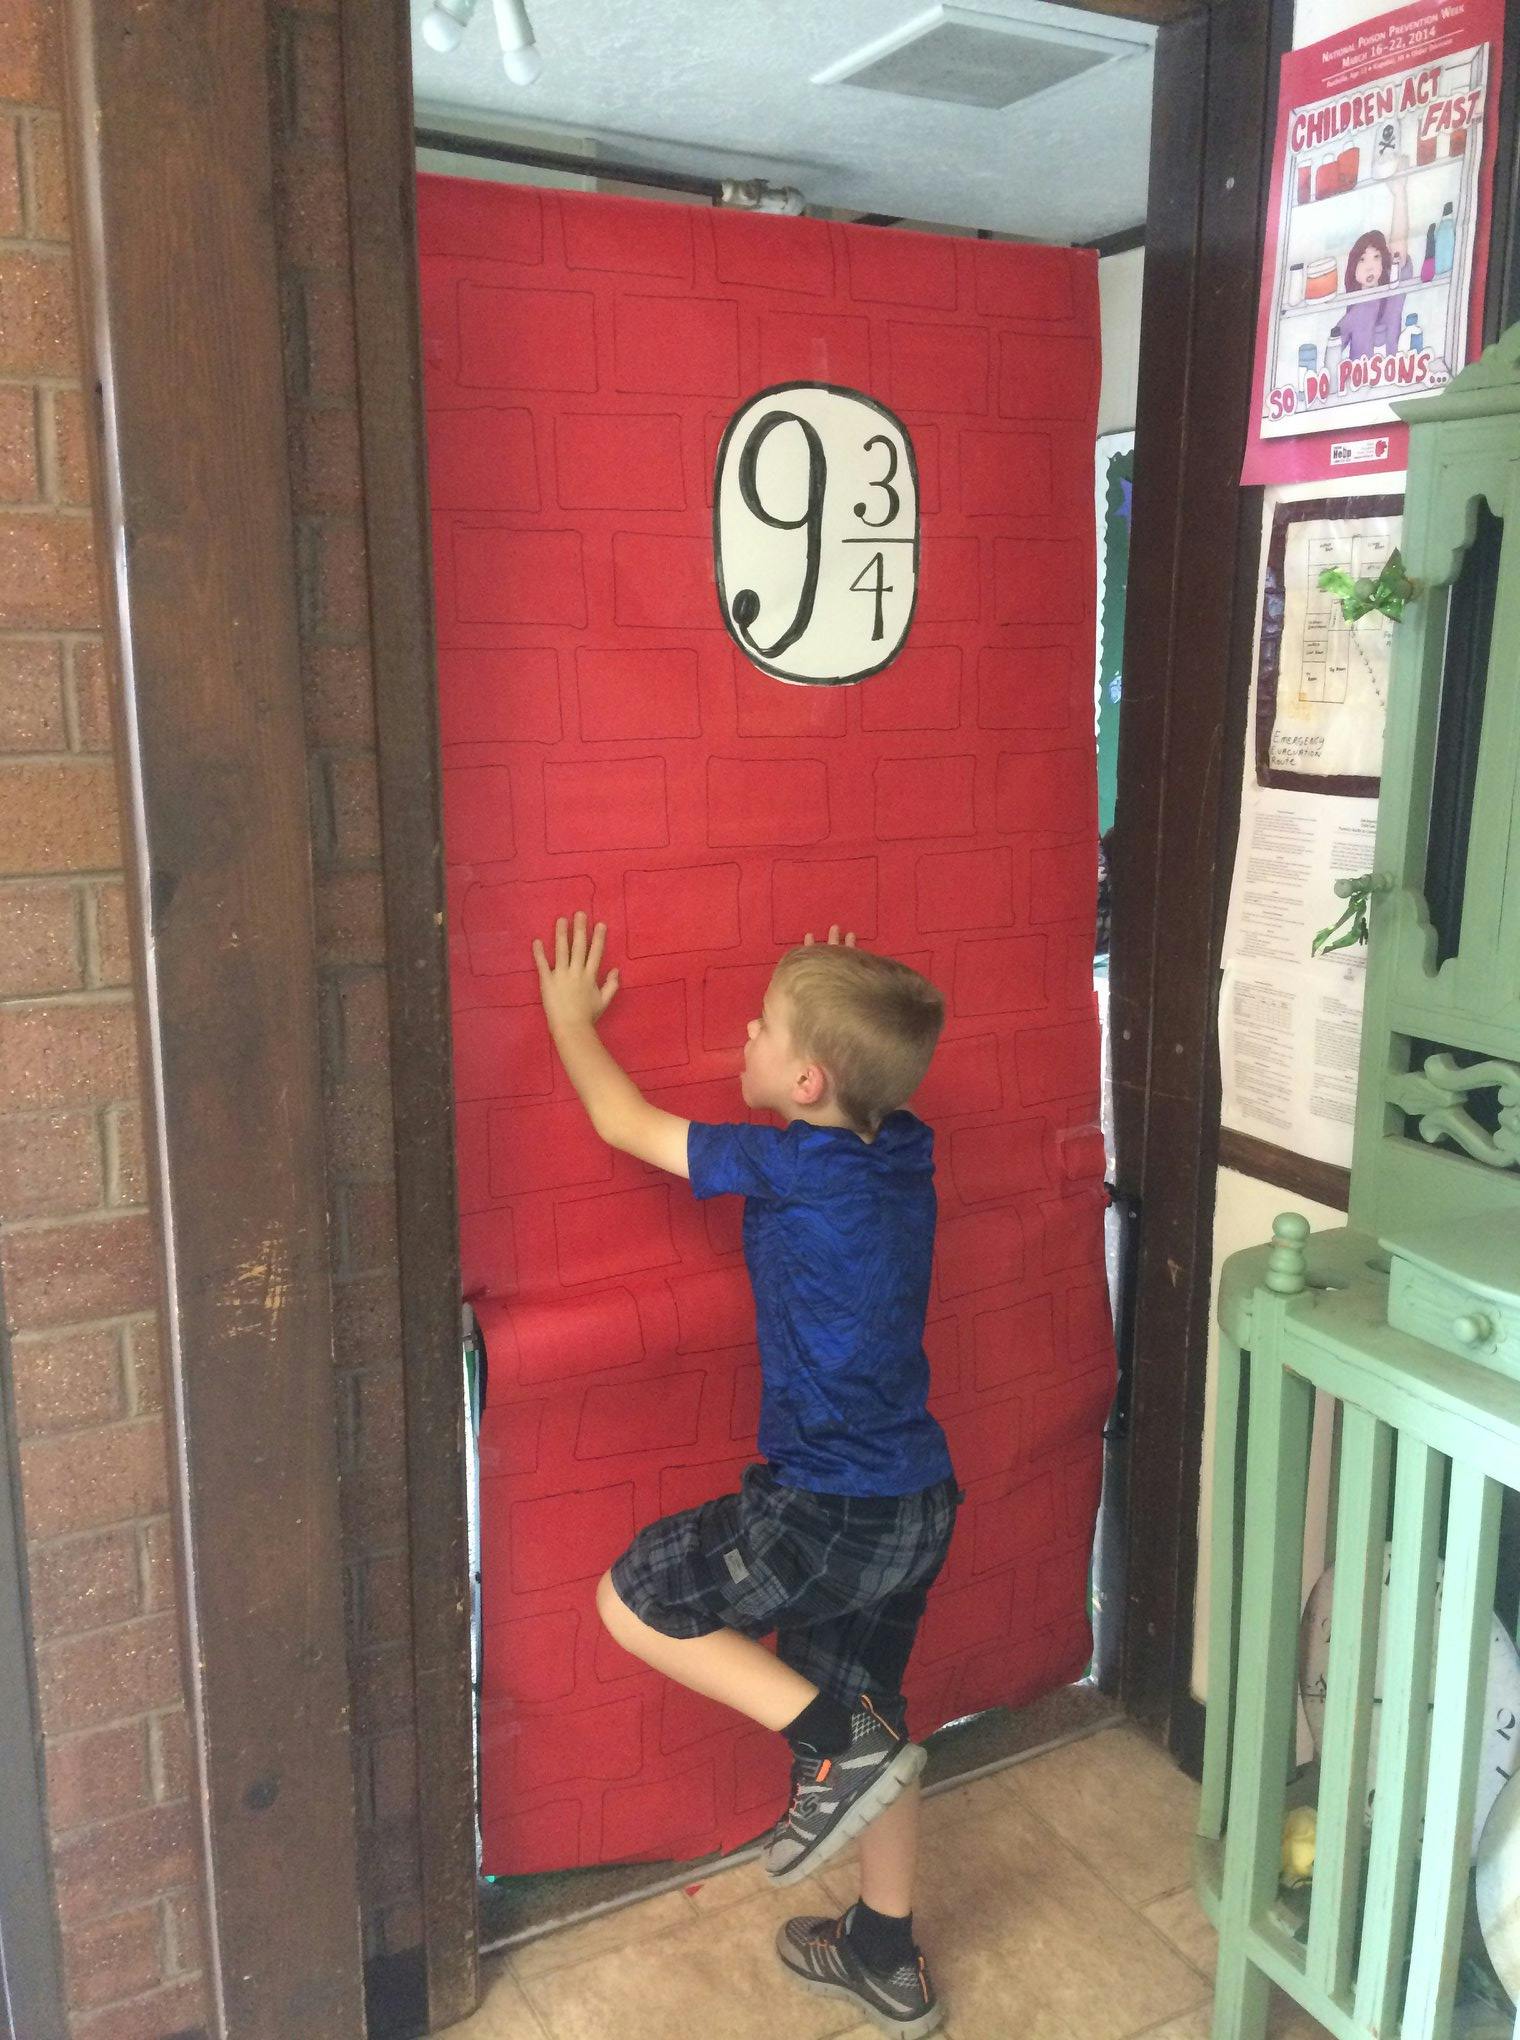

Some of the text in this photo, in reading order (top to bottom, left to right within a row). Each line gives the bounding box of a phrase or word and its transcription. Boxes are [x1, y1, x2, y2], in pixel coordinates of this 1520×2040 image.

[1408, 26, 1436, 45] 2014
[1291, 66, 1441, 153] CHILDREN ACT
[1421, 89, 1481, 138] FAST
[1269, 387, 1295, 420] SO
[1306, 373, 1330, 406] DO
[853, 434, 900, 527] 3
[732, 410, 827, 659] 9
[849, 552, 893, 641] 4
